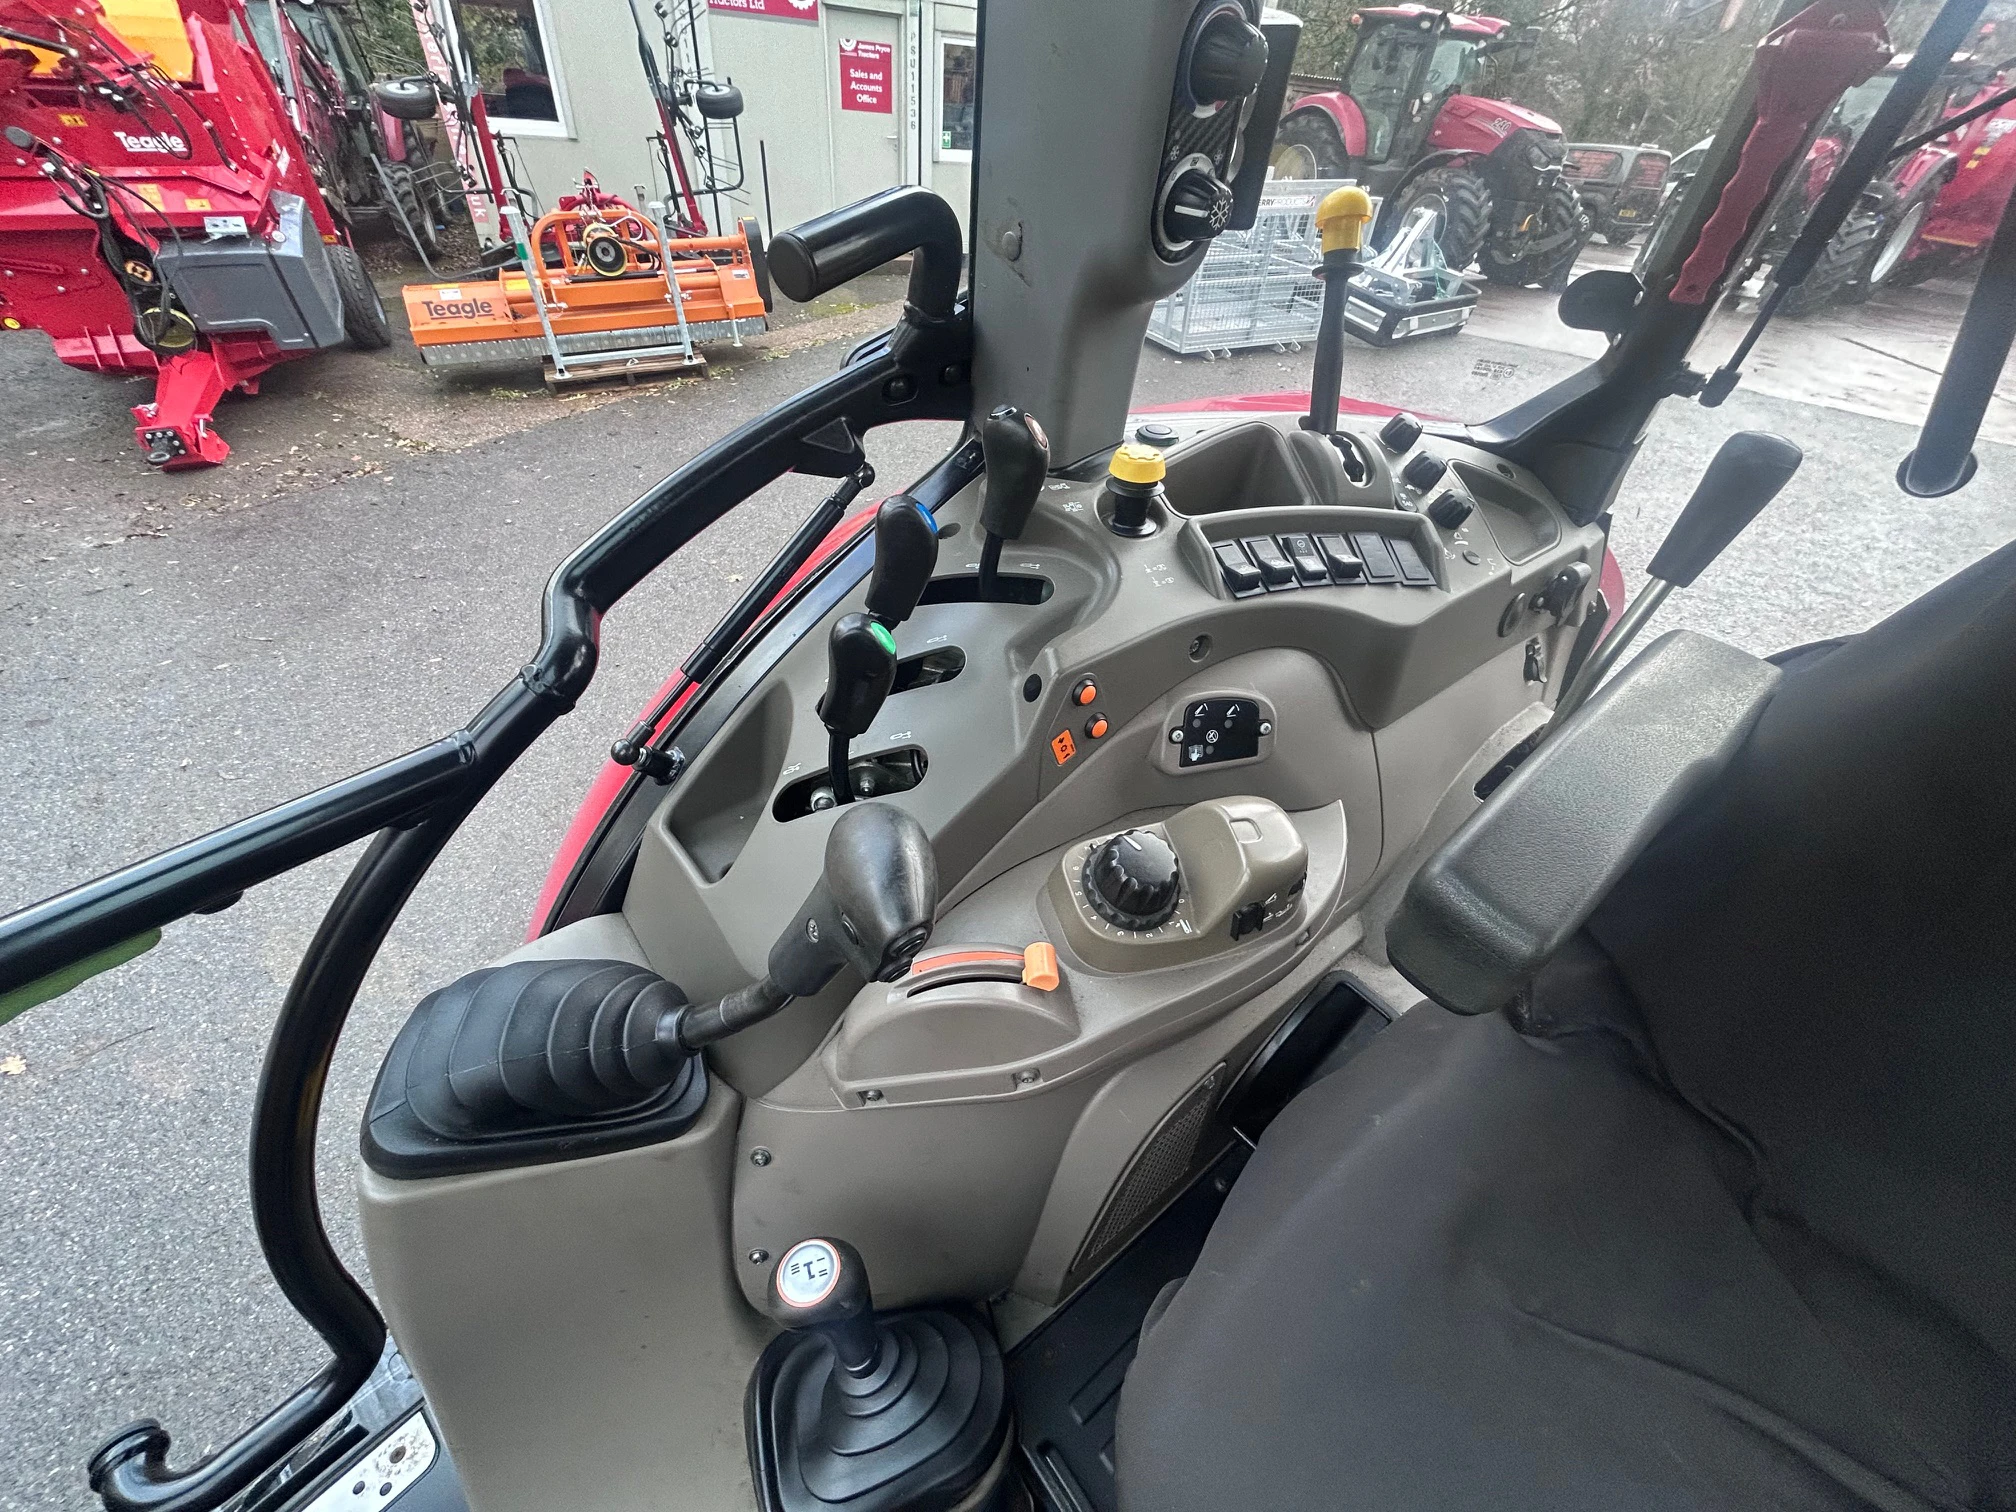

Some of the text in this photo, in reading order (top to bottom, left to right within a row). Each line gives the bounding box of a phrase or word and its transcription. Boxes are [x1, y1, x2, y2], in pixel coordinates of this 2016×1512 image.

[749, 0, 766, 10] Ltd
[850, 68, 882, 81] Sales and
[850, 81, 883, 93] Accounts
[856, 93, 878, 104] Office
[113, 131, 188, 153] Teagle
[421, 298, 495, 320] Teagle
